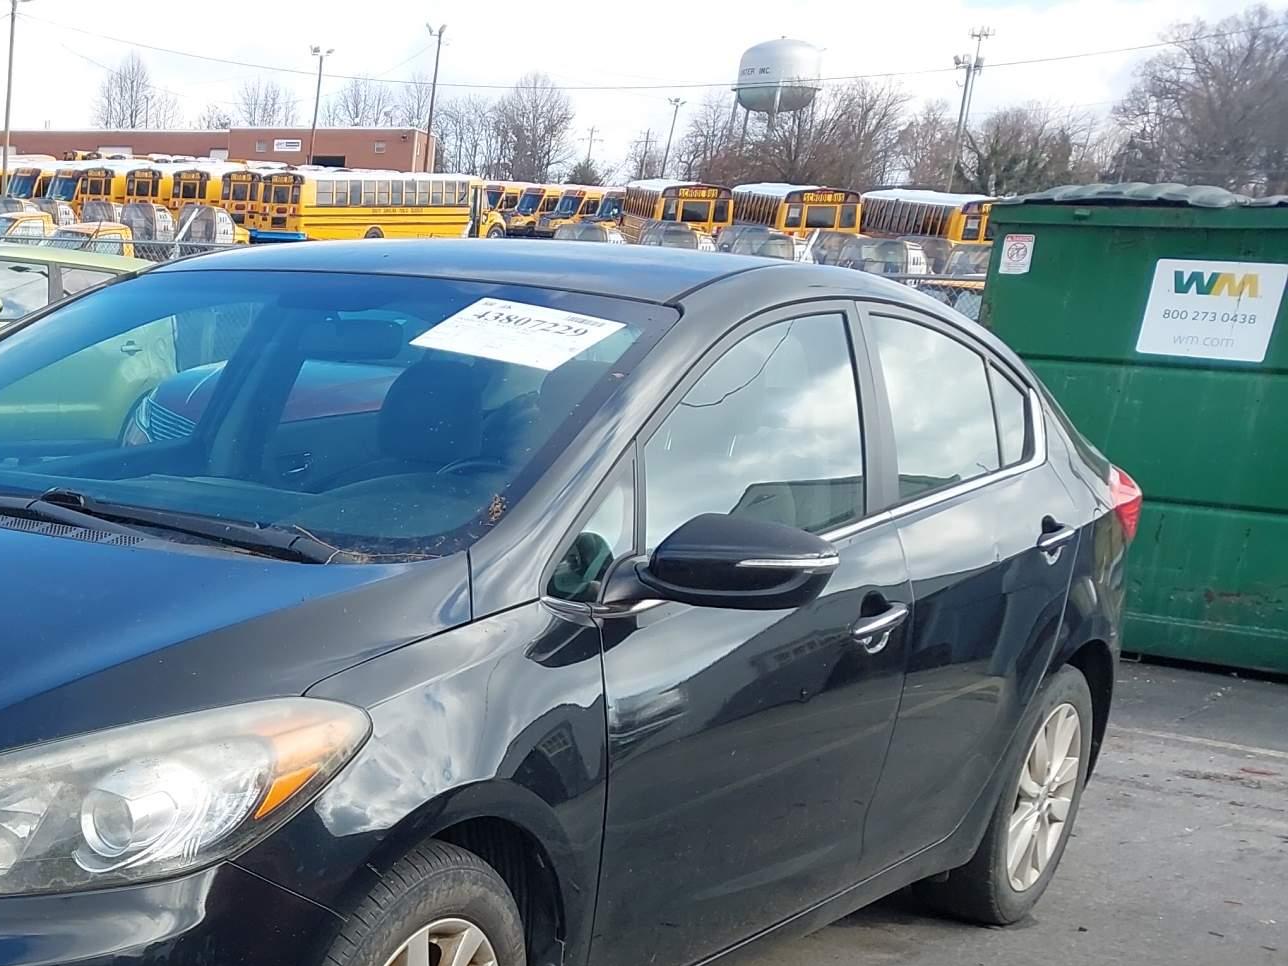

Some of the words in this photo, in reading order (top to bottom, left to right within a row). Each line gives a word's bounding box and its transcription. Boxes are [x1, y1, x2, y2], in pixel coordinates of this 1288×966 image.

[680, 188, 702, 198] SCHOOL
[804, 193, 828, 202] SCHOOL
[832, 193, 844, 202] BUS
[1173, 269, 1259, 298] WM
[473, 309, 589, 338] 43807229
[1162, 308, 1189, 321] 800
[1191, 310, 1217, 323] 273
[1220, 312, 1257, 325] 0438
[1172, 334, 1235, 348] wm.com
